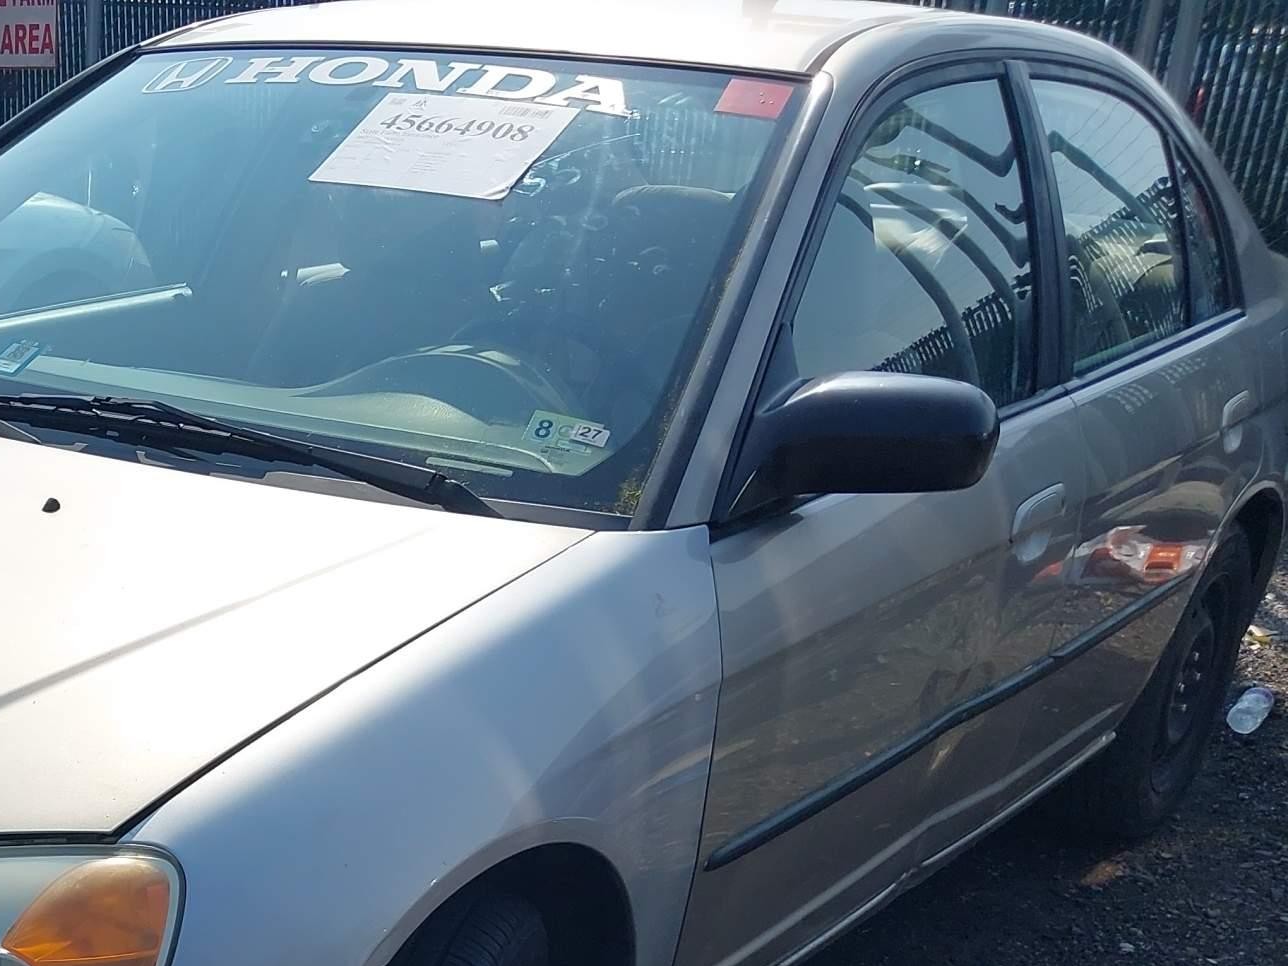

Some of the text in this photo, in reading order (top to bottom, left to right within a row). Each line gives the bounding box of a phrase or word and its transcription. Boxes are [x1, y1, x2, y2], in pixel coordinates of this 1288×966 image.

[0, 24, 54, 55] AREA
[224, 56, 633, 118] HONDA
[380, 113, 535, 142] 45664908
[534, 420, 554, 438] 8
[579, 426, 604, 439] 27
